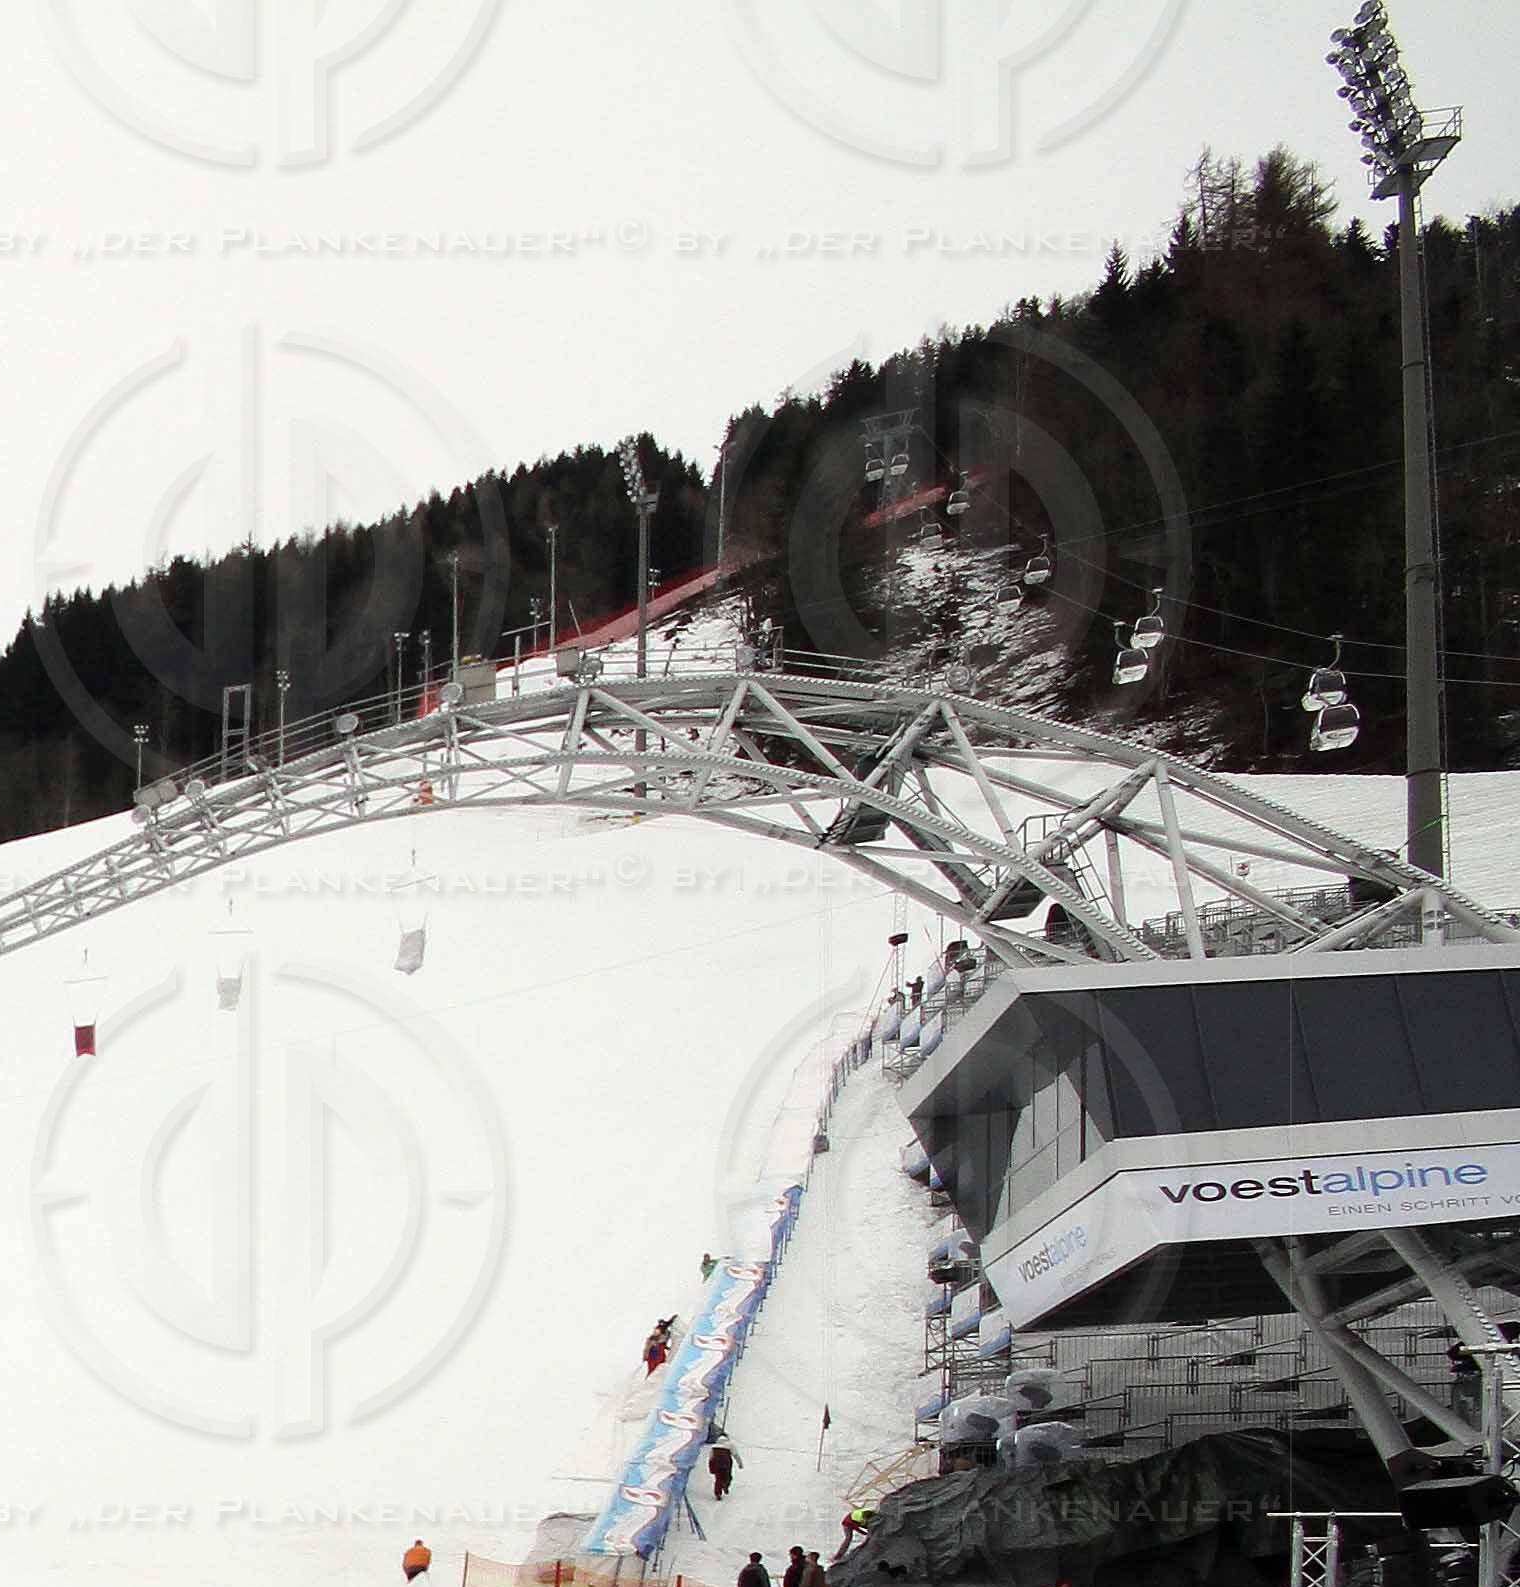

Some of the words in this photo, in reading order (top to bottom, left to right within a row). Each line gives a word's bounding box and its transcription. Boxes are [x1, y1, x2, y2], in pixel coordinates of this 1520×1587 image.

[1159, 1162, 1488, 1204] voestalpine
[1329, 1203, 1392, 1216] EINEN
[1401, 1196, 1491, 1212] SCHRITT
